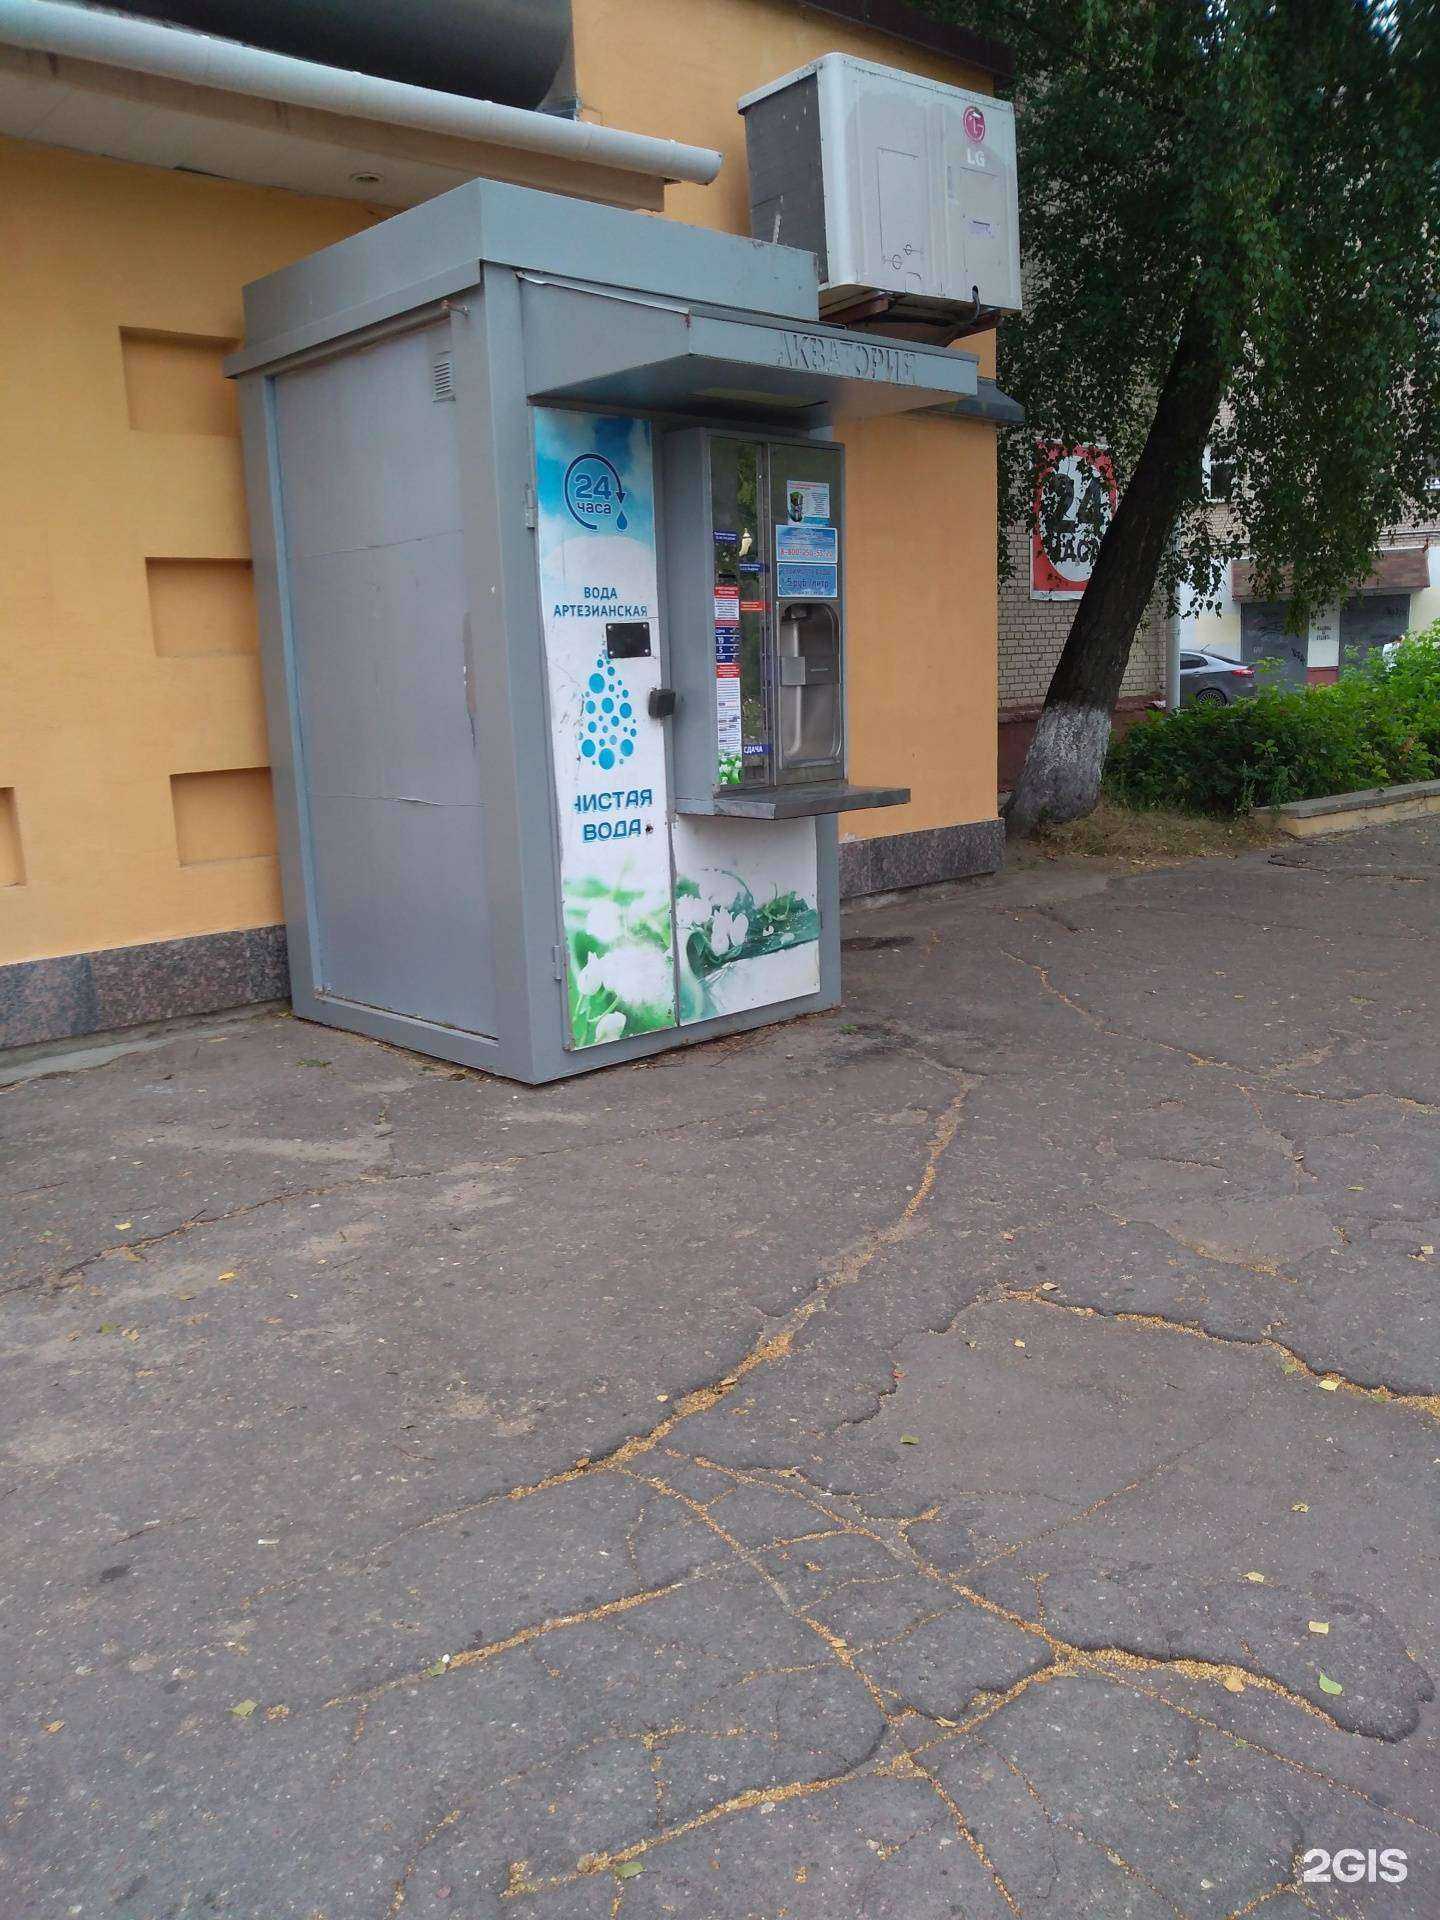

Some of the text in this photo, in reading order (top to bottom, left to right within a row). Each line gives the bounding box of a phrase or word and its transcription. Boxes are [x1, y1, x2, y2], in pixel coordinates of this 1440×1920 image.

[967, 148, 985, 168] LG
[575, 474, 612, 500] 24
[577, 502, 612, 515] часа
[1046, 473, 1102, 534] 24
[584, 587, 618, 600] ВОДА
[554, 604, 648, 617] АРТЕЗИАНСКАЯ
[743, 745, 763, 755] СДАЧА
[583, 818, 641, 841] ВОДА
